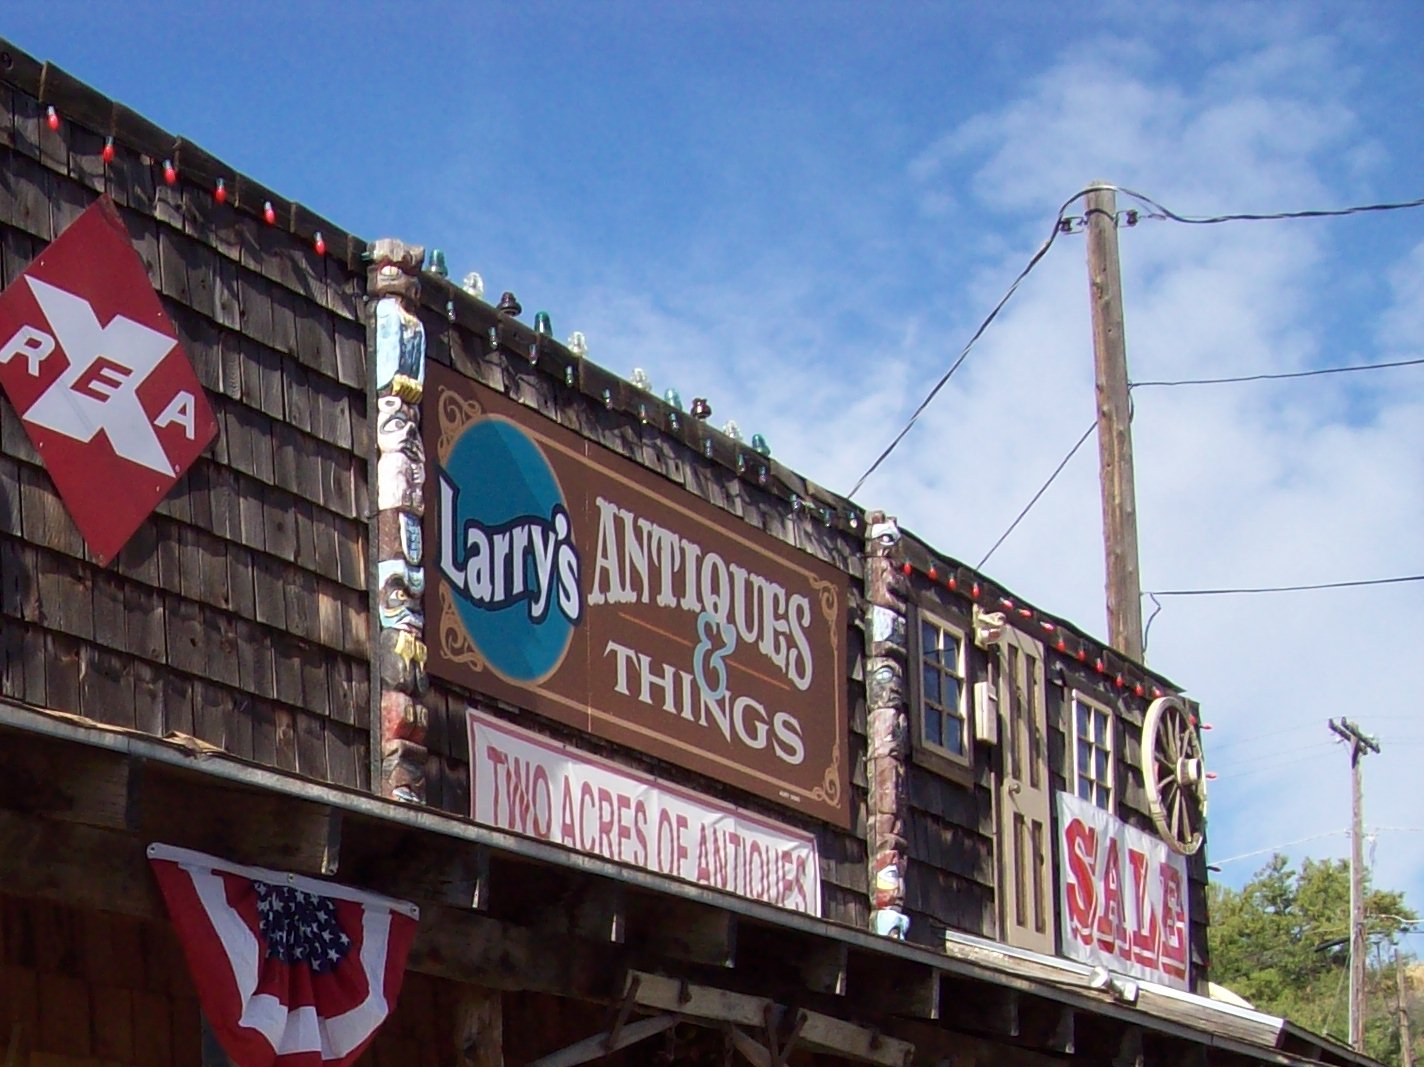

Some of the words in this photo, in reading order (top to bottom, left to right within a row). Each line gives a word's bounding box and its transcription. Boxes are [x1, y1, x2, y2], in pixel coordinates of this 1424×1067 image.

[438, 474, 581, 622] Larry's
[587, 496, 813, 692] ANTIQUES
[603, 640, 806, 766] THINGS
[692, 611, 736, 700] &
[486, 746, 554, 840] TWO
[559, 774, 648, 869] ACRES
[656, 807, 689, 876] OF
[695, 822, 809, 914] ANTIQUES
[1065, 817, 1186, 981] SALE
